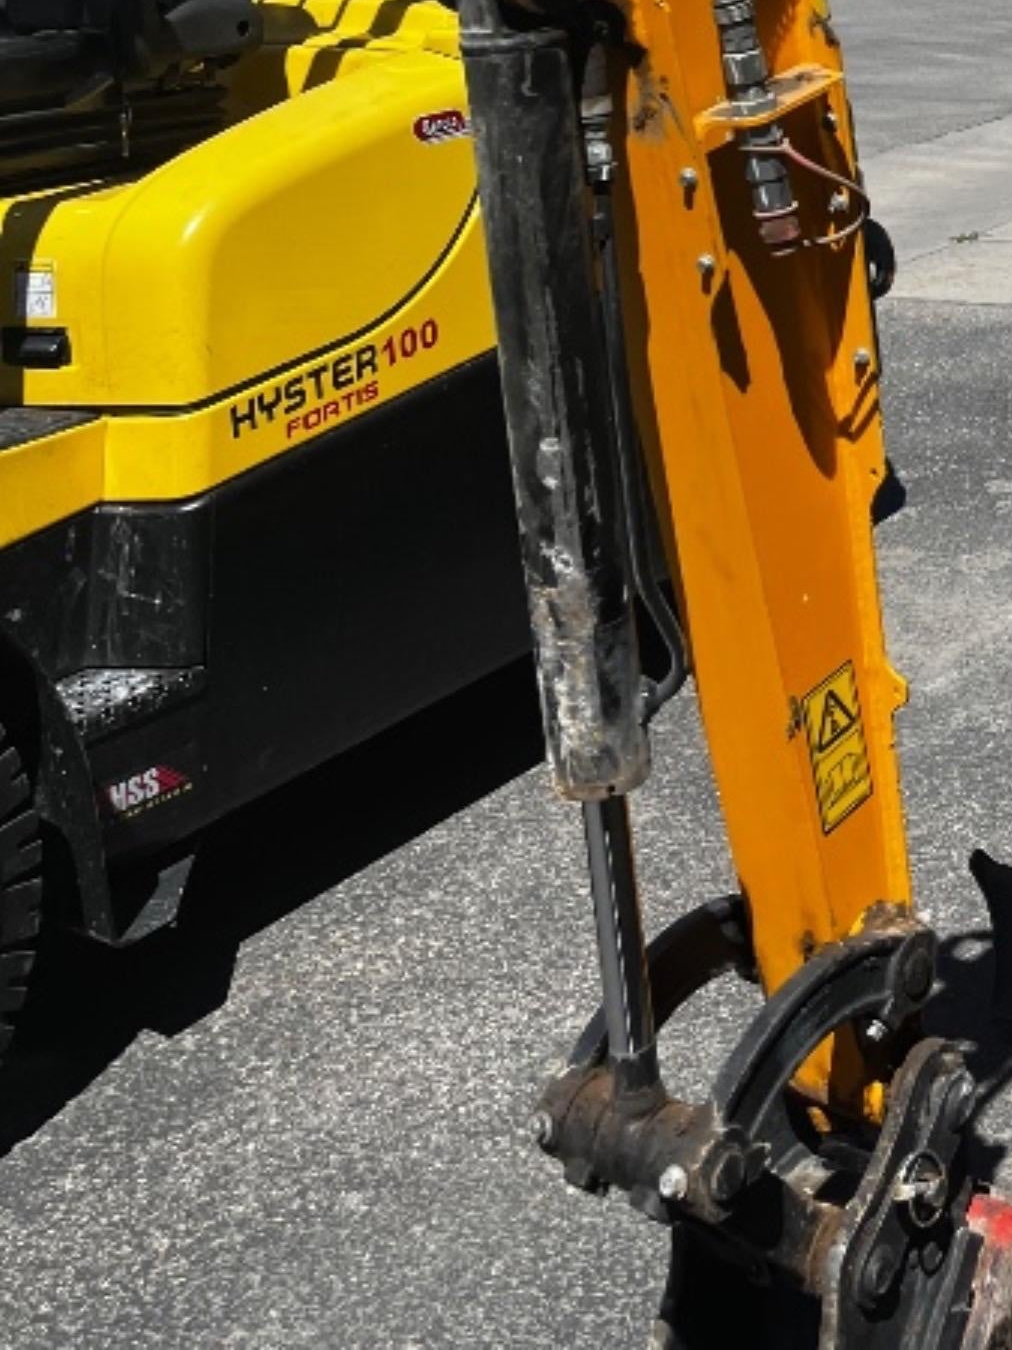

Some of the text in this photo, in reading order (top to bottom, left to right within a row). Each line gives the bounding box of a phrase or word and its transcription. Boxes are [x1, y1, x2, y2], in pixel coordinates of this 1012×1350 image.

[230, 317, 439, 439] HYSTER 100
[286, 380, 379, 439] FORTIS
